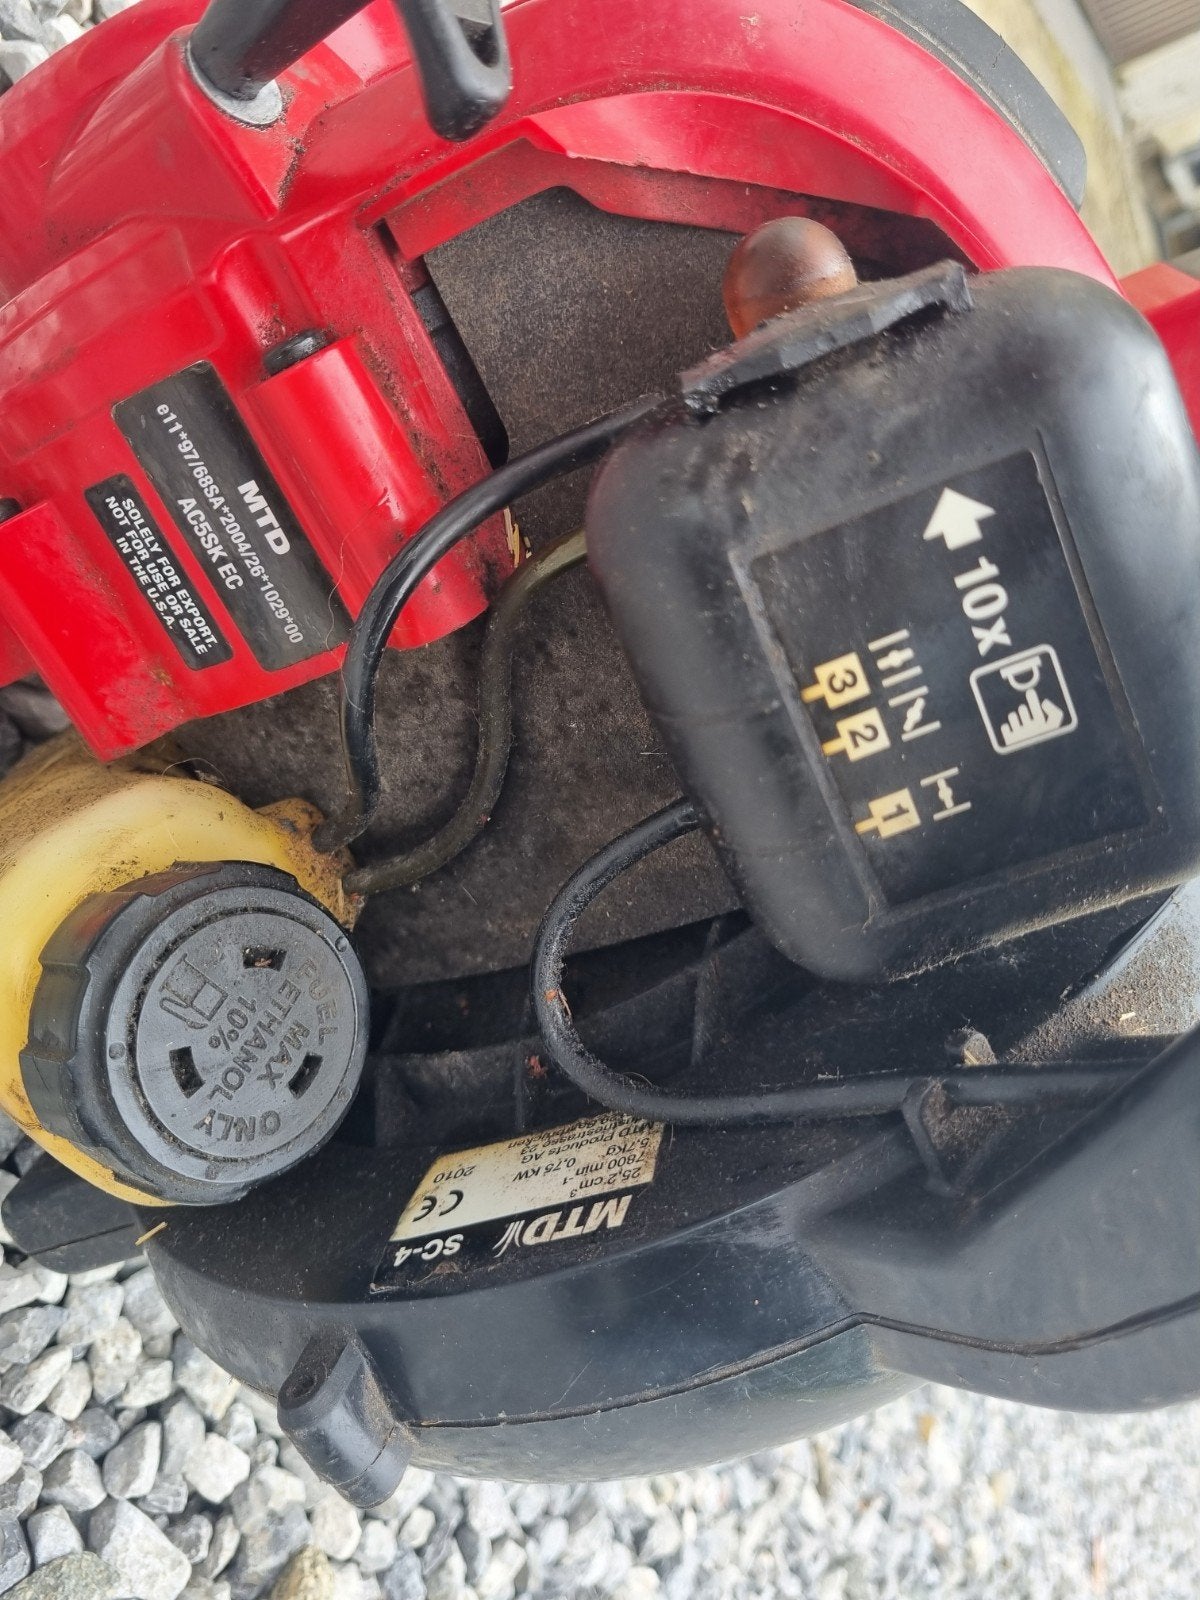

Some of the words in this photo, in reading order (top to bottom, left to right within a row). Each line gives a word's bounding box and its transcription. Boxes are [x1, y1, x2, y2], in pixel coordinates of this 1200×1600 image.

[237, 480, 291, 555] MTD
[177, 498, 228, 563] AC5SK
[218, 562, 244, 590] EC
[106, 496, 131, 526] NOT
[126, 530, 150, 560] FOR
[146, 562, 170, 593] USE
[166, 594, 184, 616] OR
[179, 618, 208, 655] SALE
[116, 538, 132, 554] IN
[129, 556, 151, 586] THE
[147, 587, 175, 630] U.S.A.
[122, 498, 162, 554] SOLELY
[157, 556, 182, 588] FOR
[176, 589, 218, 648] EXPORT.
[954, 556, 1012, 657] 10x
[828, 670, 858, 694] 3
[850, 724, 878, 748] 2
[882, 803, 910, 822] 1
[299, 958, 338, 1045] FUEL
[208, 996, 257, 1050] 10%
[208, 979, 301, 1101] ETHANOL
[256, 1020, 310, 1090] MAX
[193, 1109, 281, 1142] ONLY
[548, 1131, 615, 1155] Products
[433, 1165, 477, 1184] 2010
[512, 1167, 542, 1182] KW
[521, 1150, 545, 1164] AG
[608, 1152, 645, 1168] 7800
[412, 1190, 464, 1222] CE
[522, 1194, 633, 1246] MTD
[394, 1234, 464, 1267] SC-4
